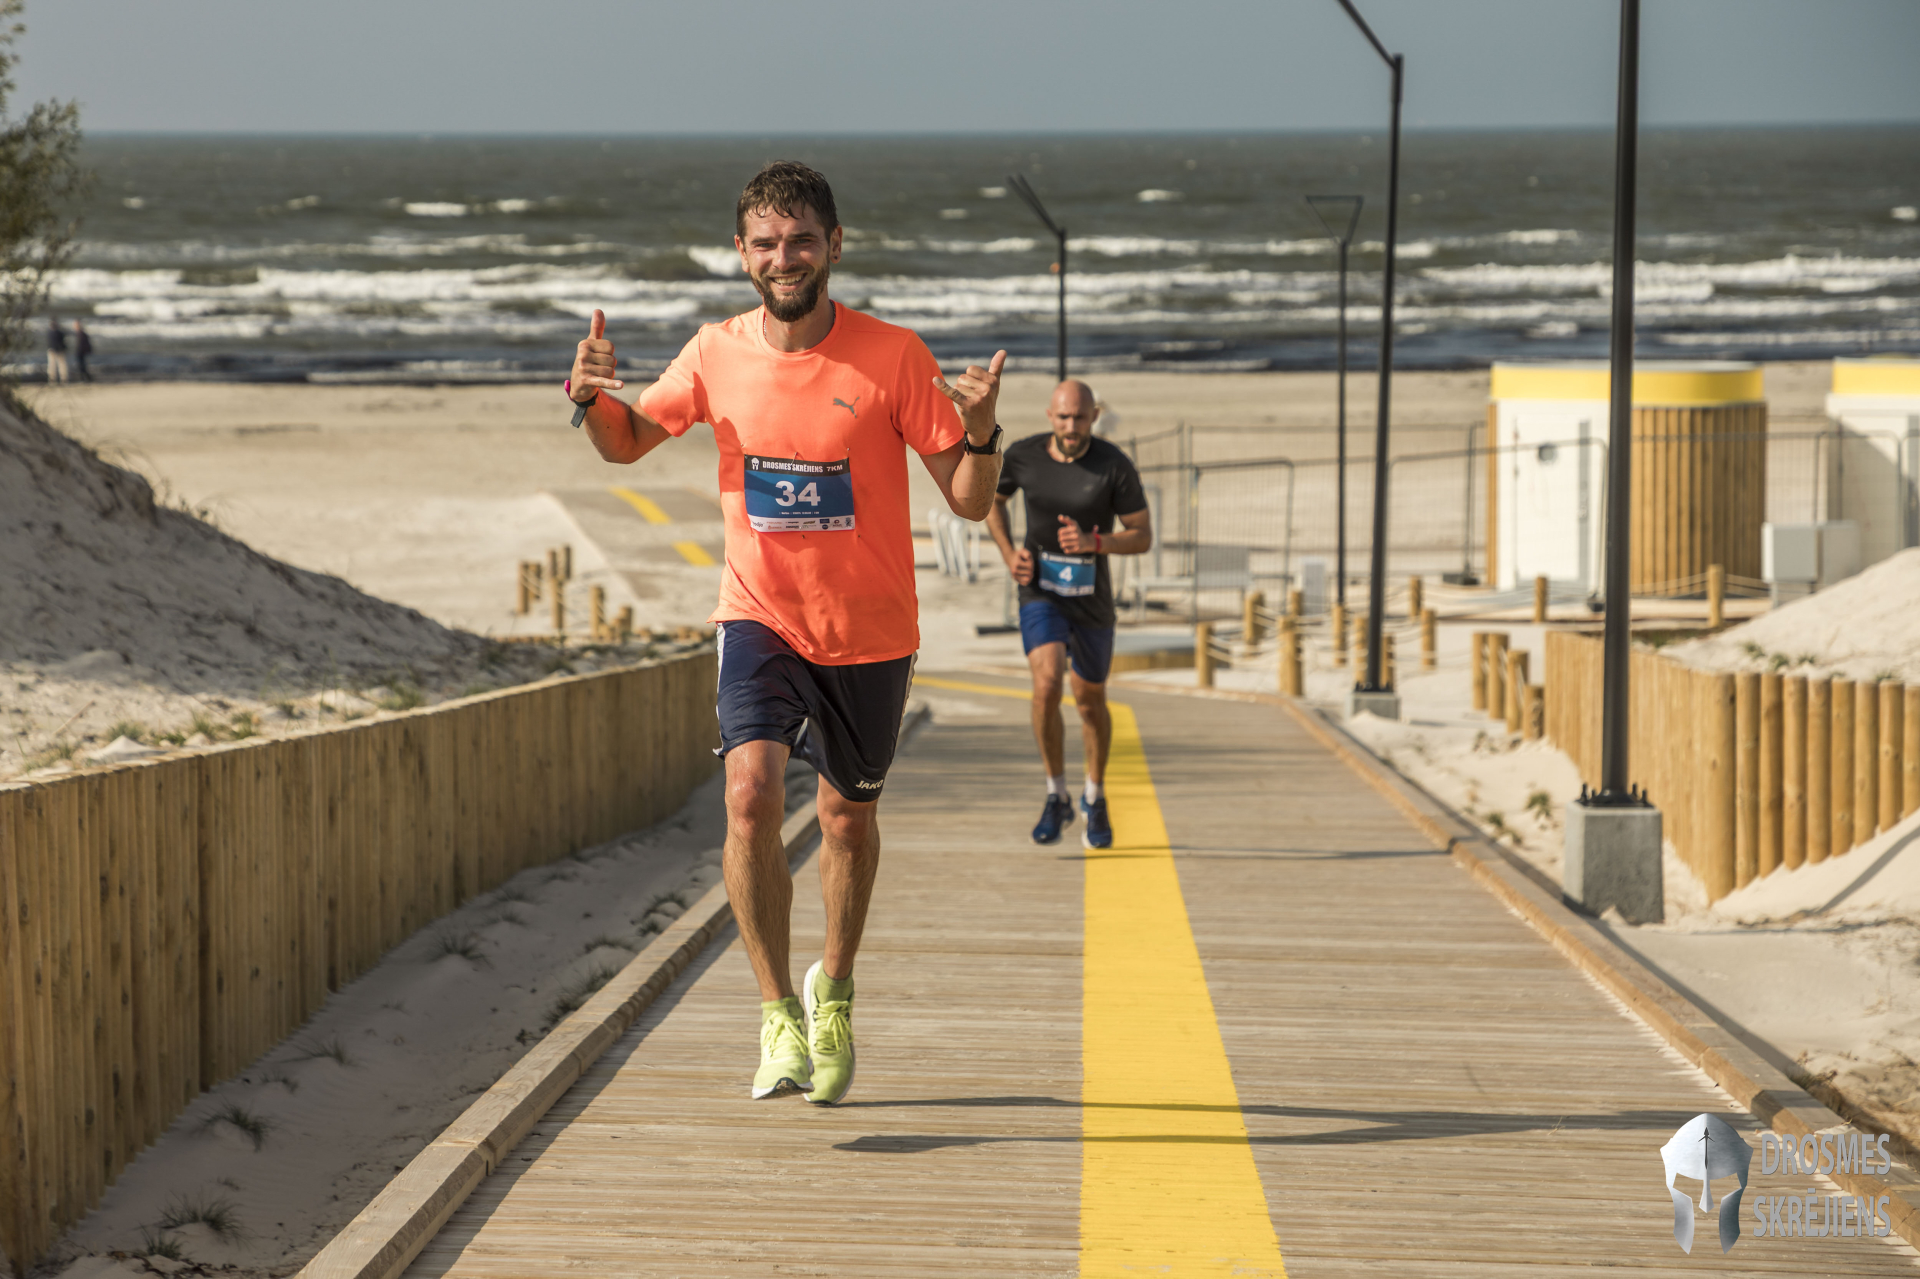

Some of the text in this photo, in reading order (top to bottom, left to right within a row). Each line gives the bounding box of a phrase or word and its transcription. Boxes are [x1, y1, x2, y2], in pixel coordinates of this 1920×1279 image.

[762, 460, 792, 471] DROSMES
[826, 464, 843, 472] 7KM
[775, 480, 821, 507] 34
[1058, 565, 1074, 582] 4
[855, 779, 884, 790] JAKO
